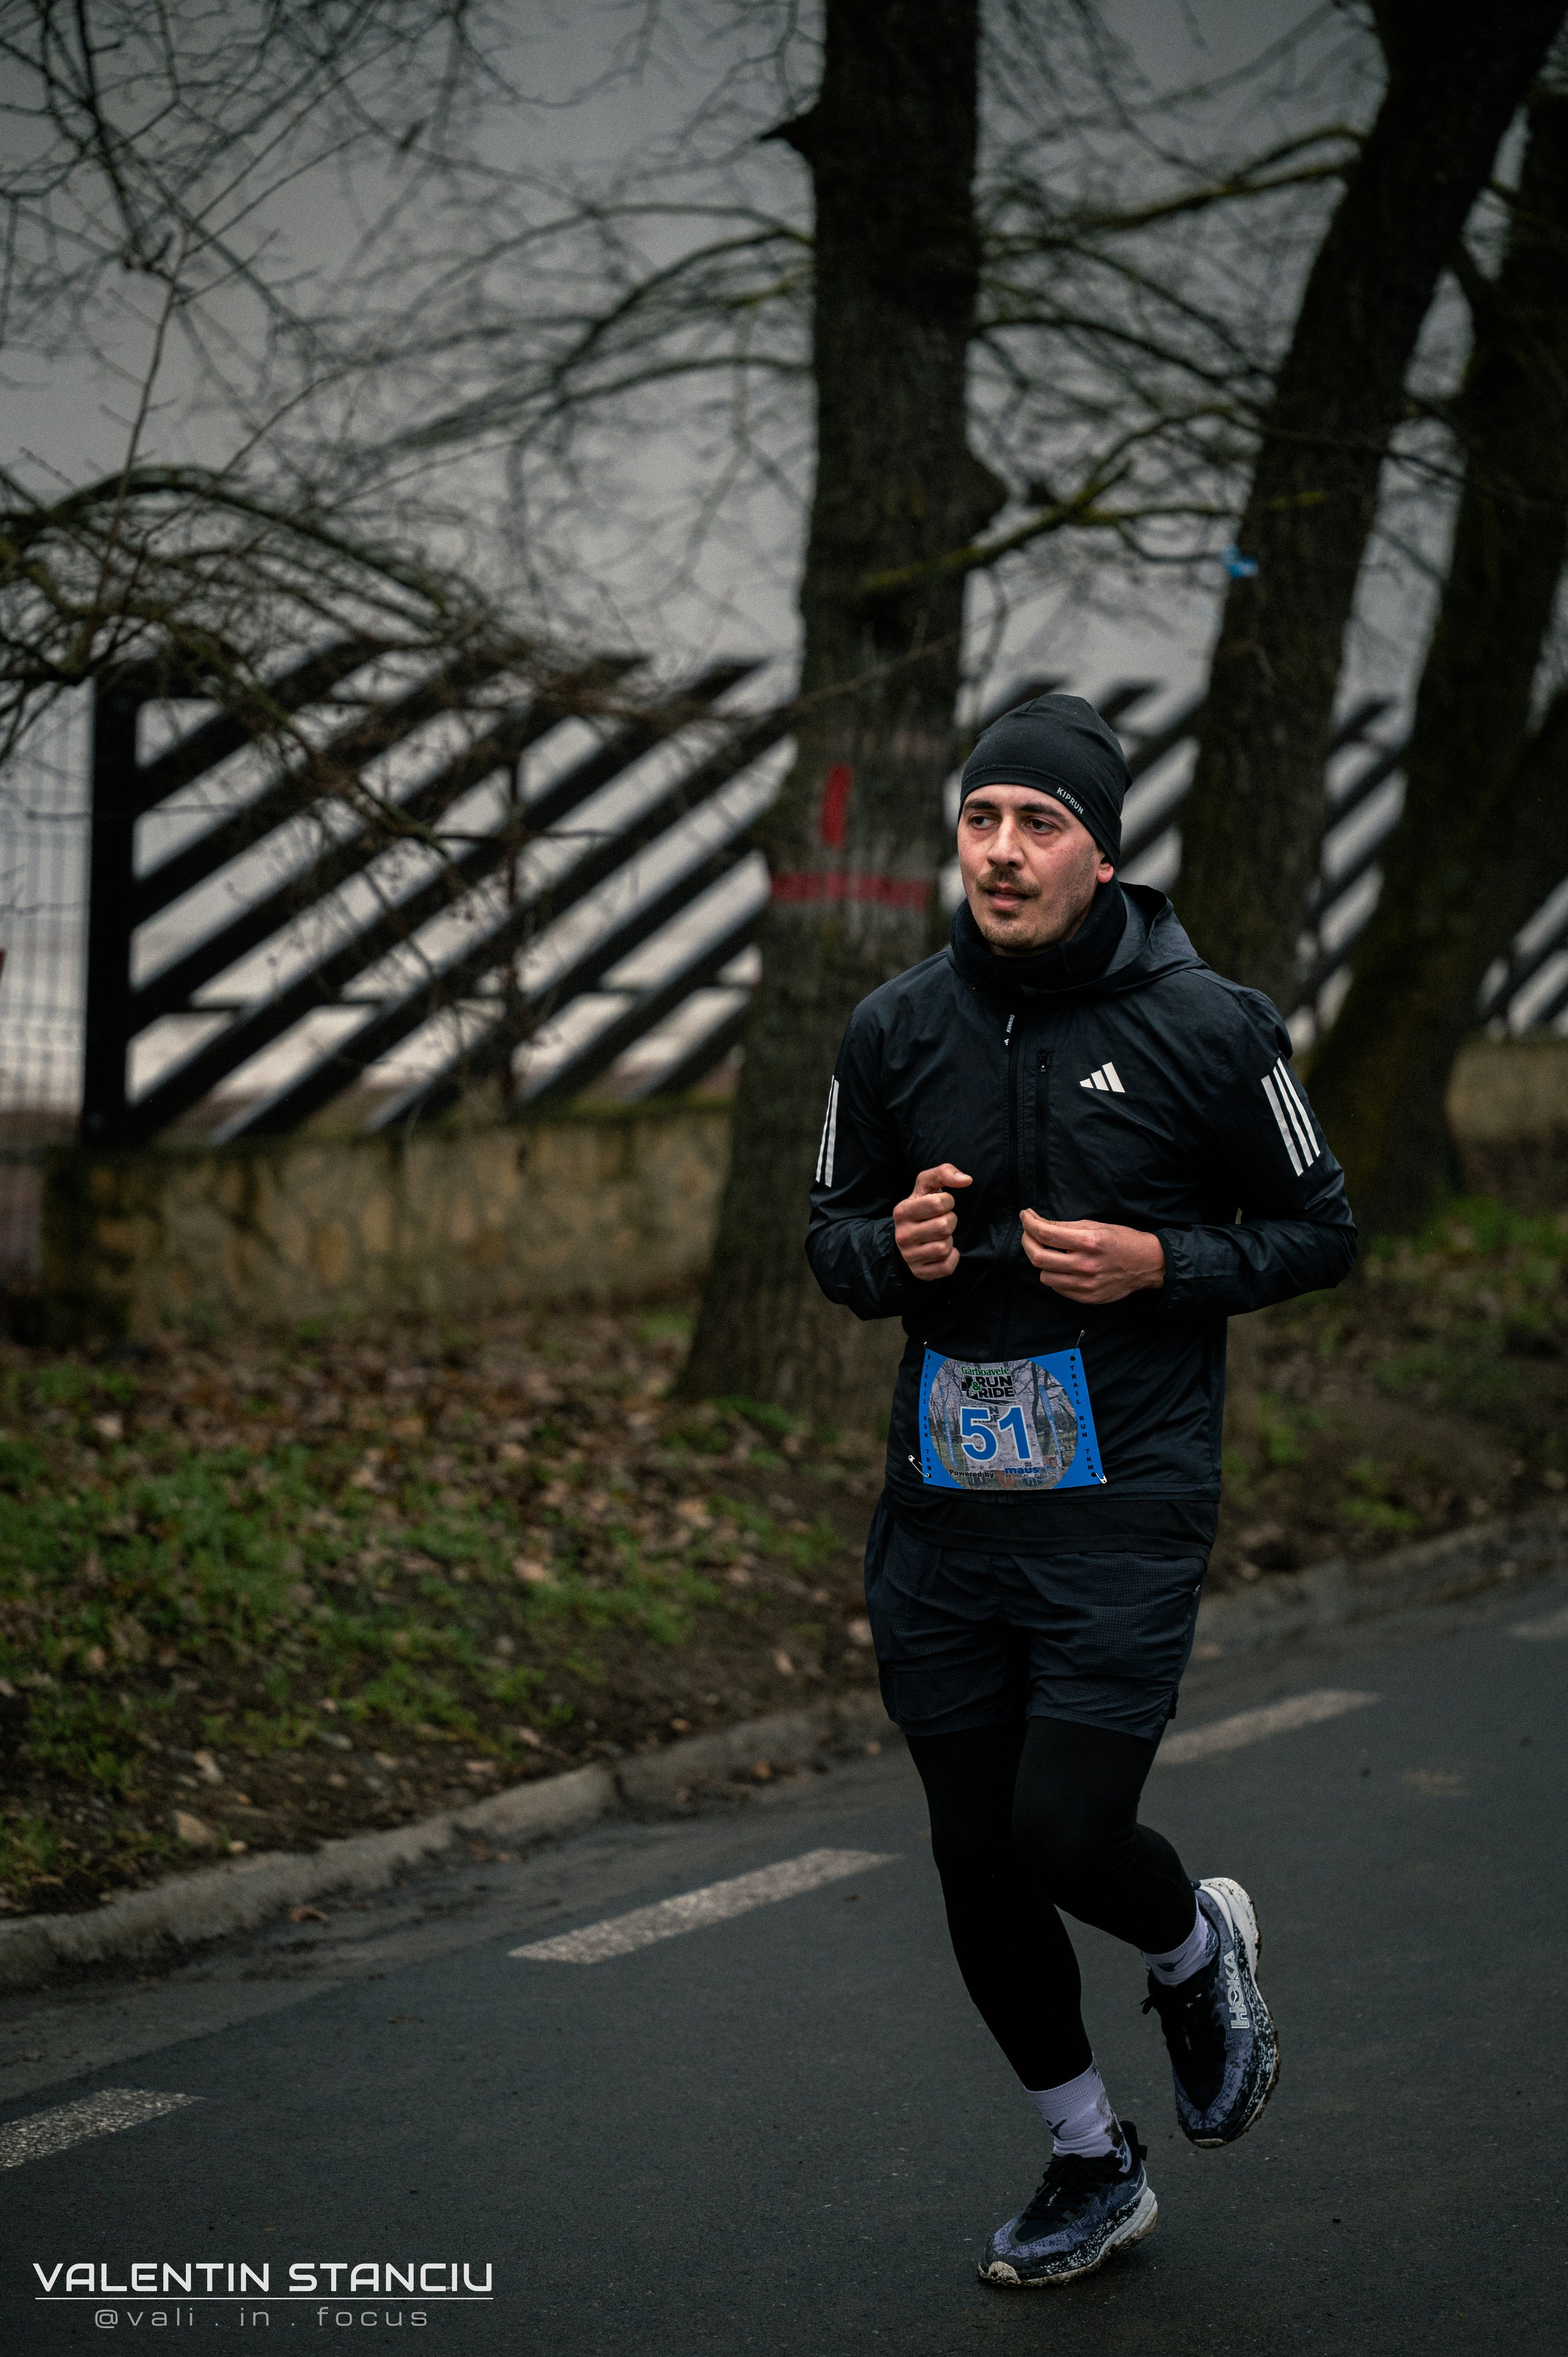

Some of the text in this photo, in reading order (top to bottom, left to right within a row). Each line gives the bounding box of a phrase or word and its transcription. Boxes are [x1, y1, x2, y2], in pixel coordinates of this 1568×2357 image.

[1057, 787, 1084, 815] KIPRUN
[1006, 1014, 1015, 1033] RUNNING
[961, 1366, 1009, 1376] Gârboavele
[972, 1381, 981, 1390] &
[976, 1376, 1013, 1387] RUN
[1069, 1365, 1081, 1405] TRAIL
[979, 1387, 1015, 1398] RIDE
[960, 1405, 1032, 1462] 51
[949, 1469, 982, 1477] Powered
[1223, 1950, 1250, 2029] HOKA
